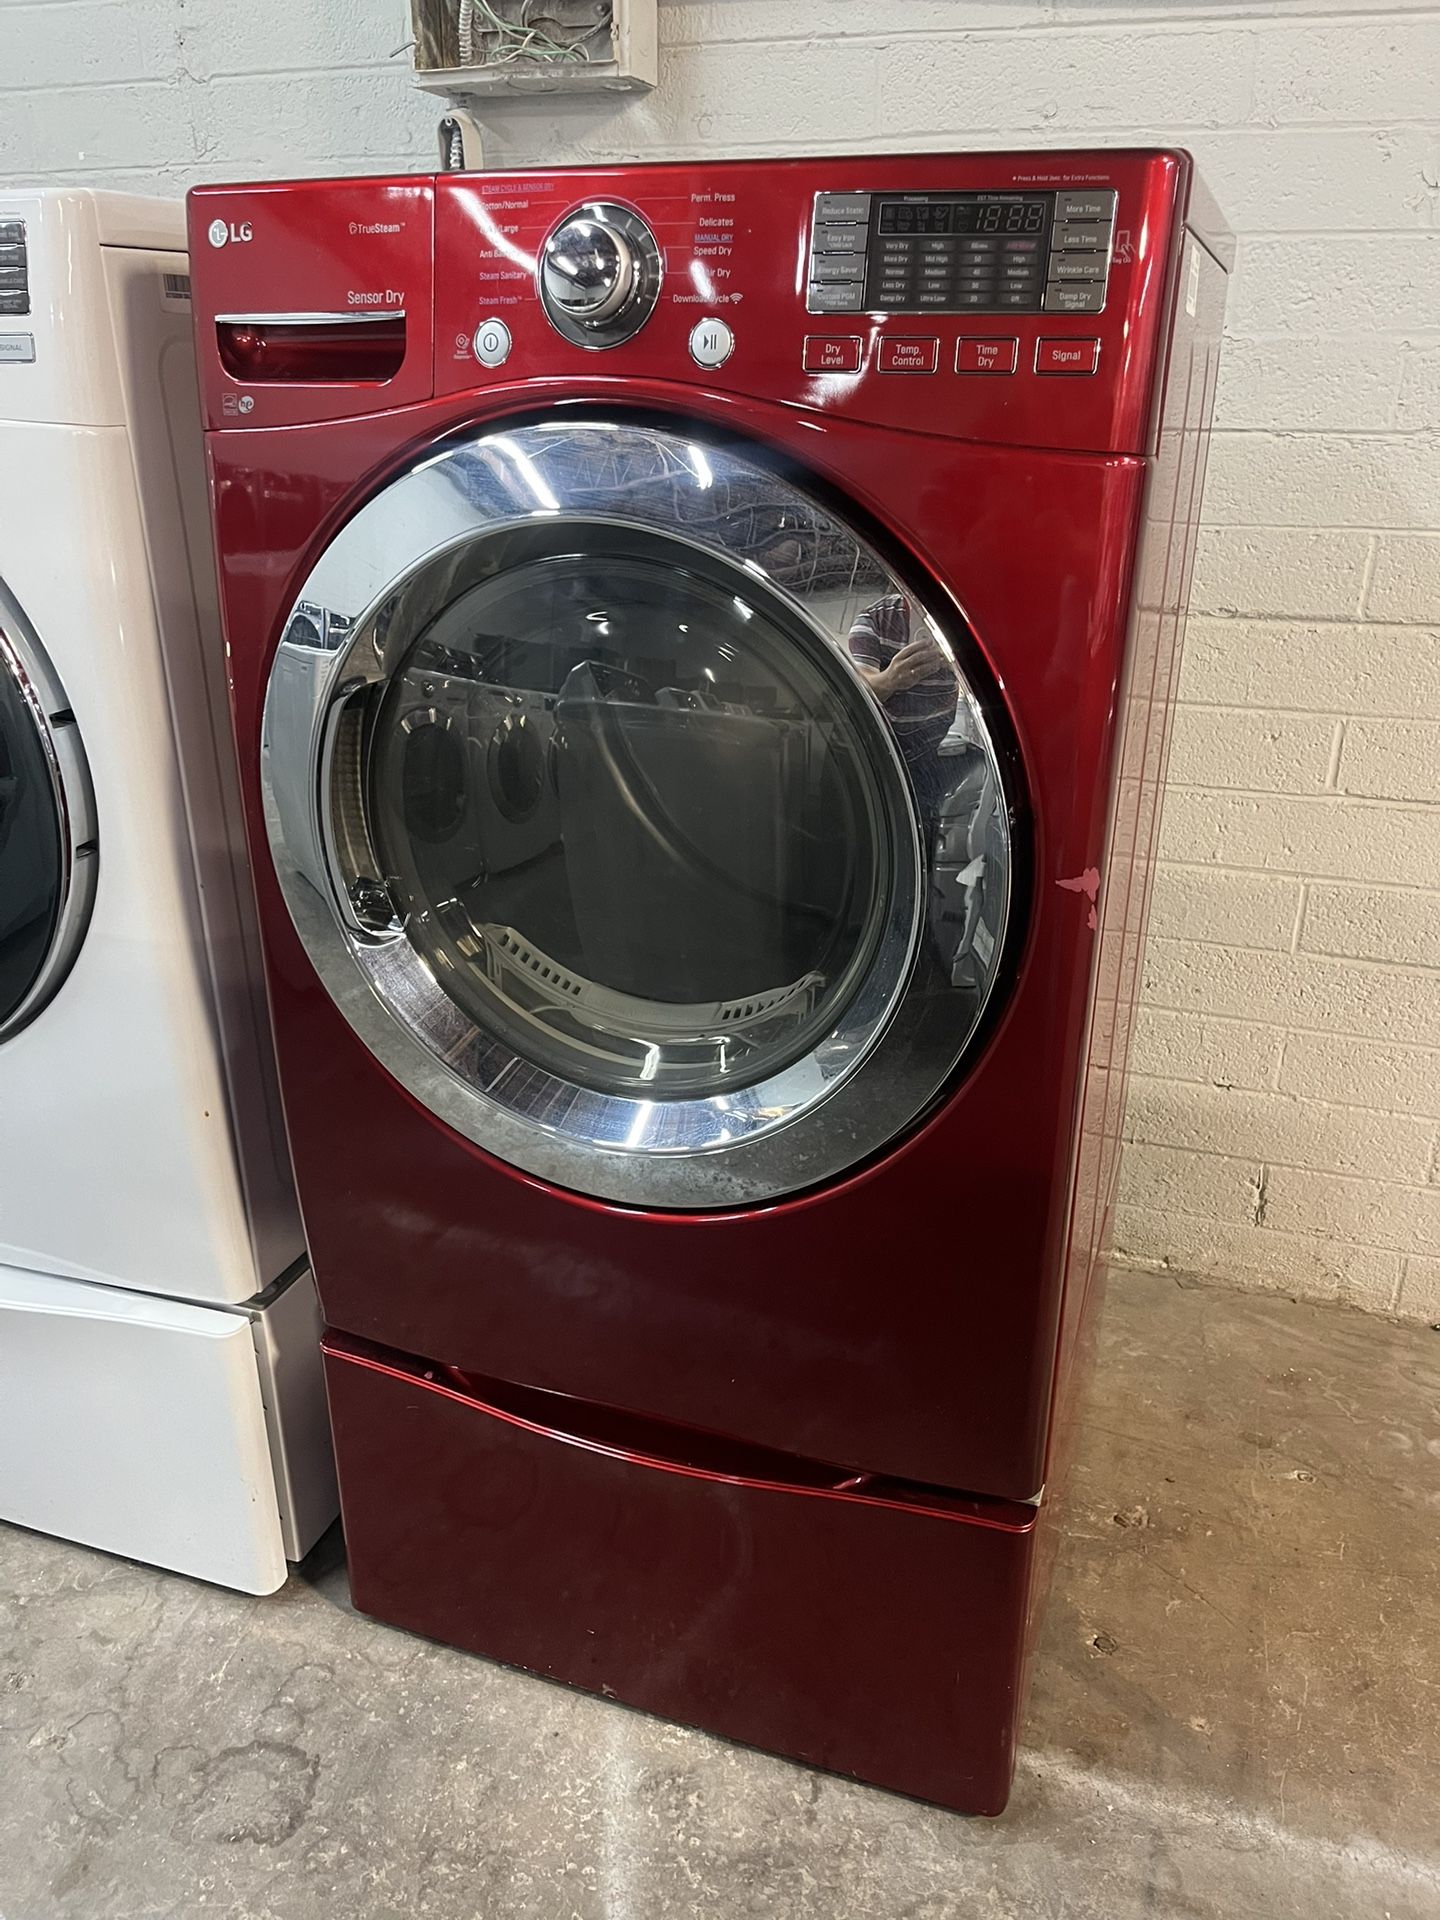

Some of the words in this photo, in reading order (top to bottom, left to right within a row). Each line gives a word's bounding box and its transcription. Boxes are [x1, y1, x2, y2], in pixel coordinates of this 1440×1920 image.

[714, 192, 735, 201] Press
[699, 217, 734, 226] Delicates
[230, 222, 253, 242] LG
[695, 234, 719, 242] MANUAL
[721, 233, 733, 241] DRY
[1081, 235, 1097, 243] Time
[480, 250, 493, 258] Anti
[694, 246, 717, 256] Speed
[718, 246, 732, 256] Dry
[717, 268, 731, 278] Dry
[1057, 266, 1082, 274] Wrinkle
[1084, 266, 1099, 274] Care
[479, 272, 499, 280] Steam
[500, 271, 527, 280] Sanitary
[347, 290, 384, 304] Sensor
[385, 289, 405, 306] Dry
[479, 297, 499, 305] Steam
[1060, 293, 1077, 301] Damp
[1078, 292, 1092, 300] Dry
[825, 343, 841, 355] Dry
[895, 344, 922, 355] Temp.
[976, 344, 998, 355] Time
[821, 355, 844, 365] Level
[892, 355, 924, 366] Control
[1052, 350, 1081, 362] Signal
[978, 356, 994, 368] Dry
